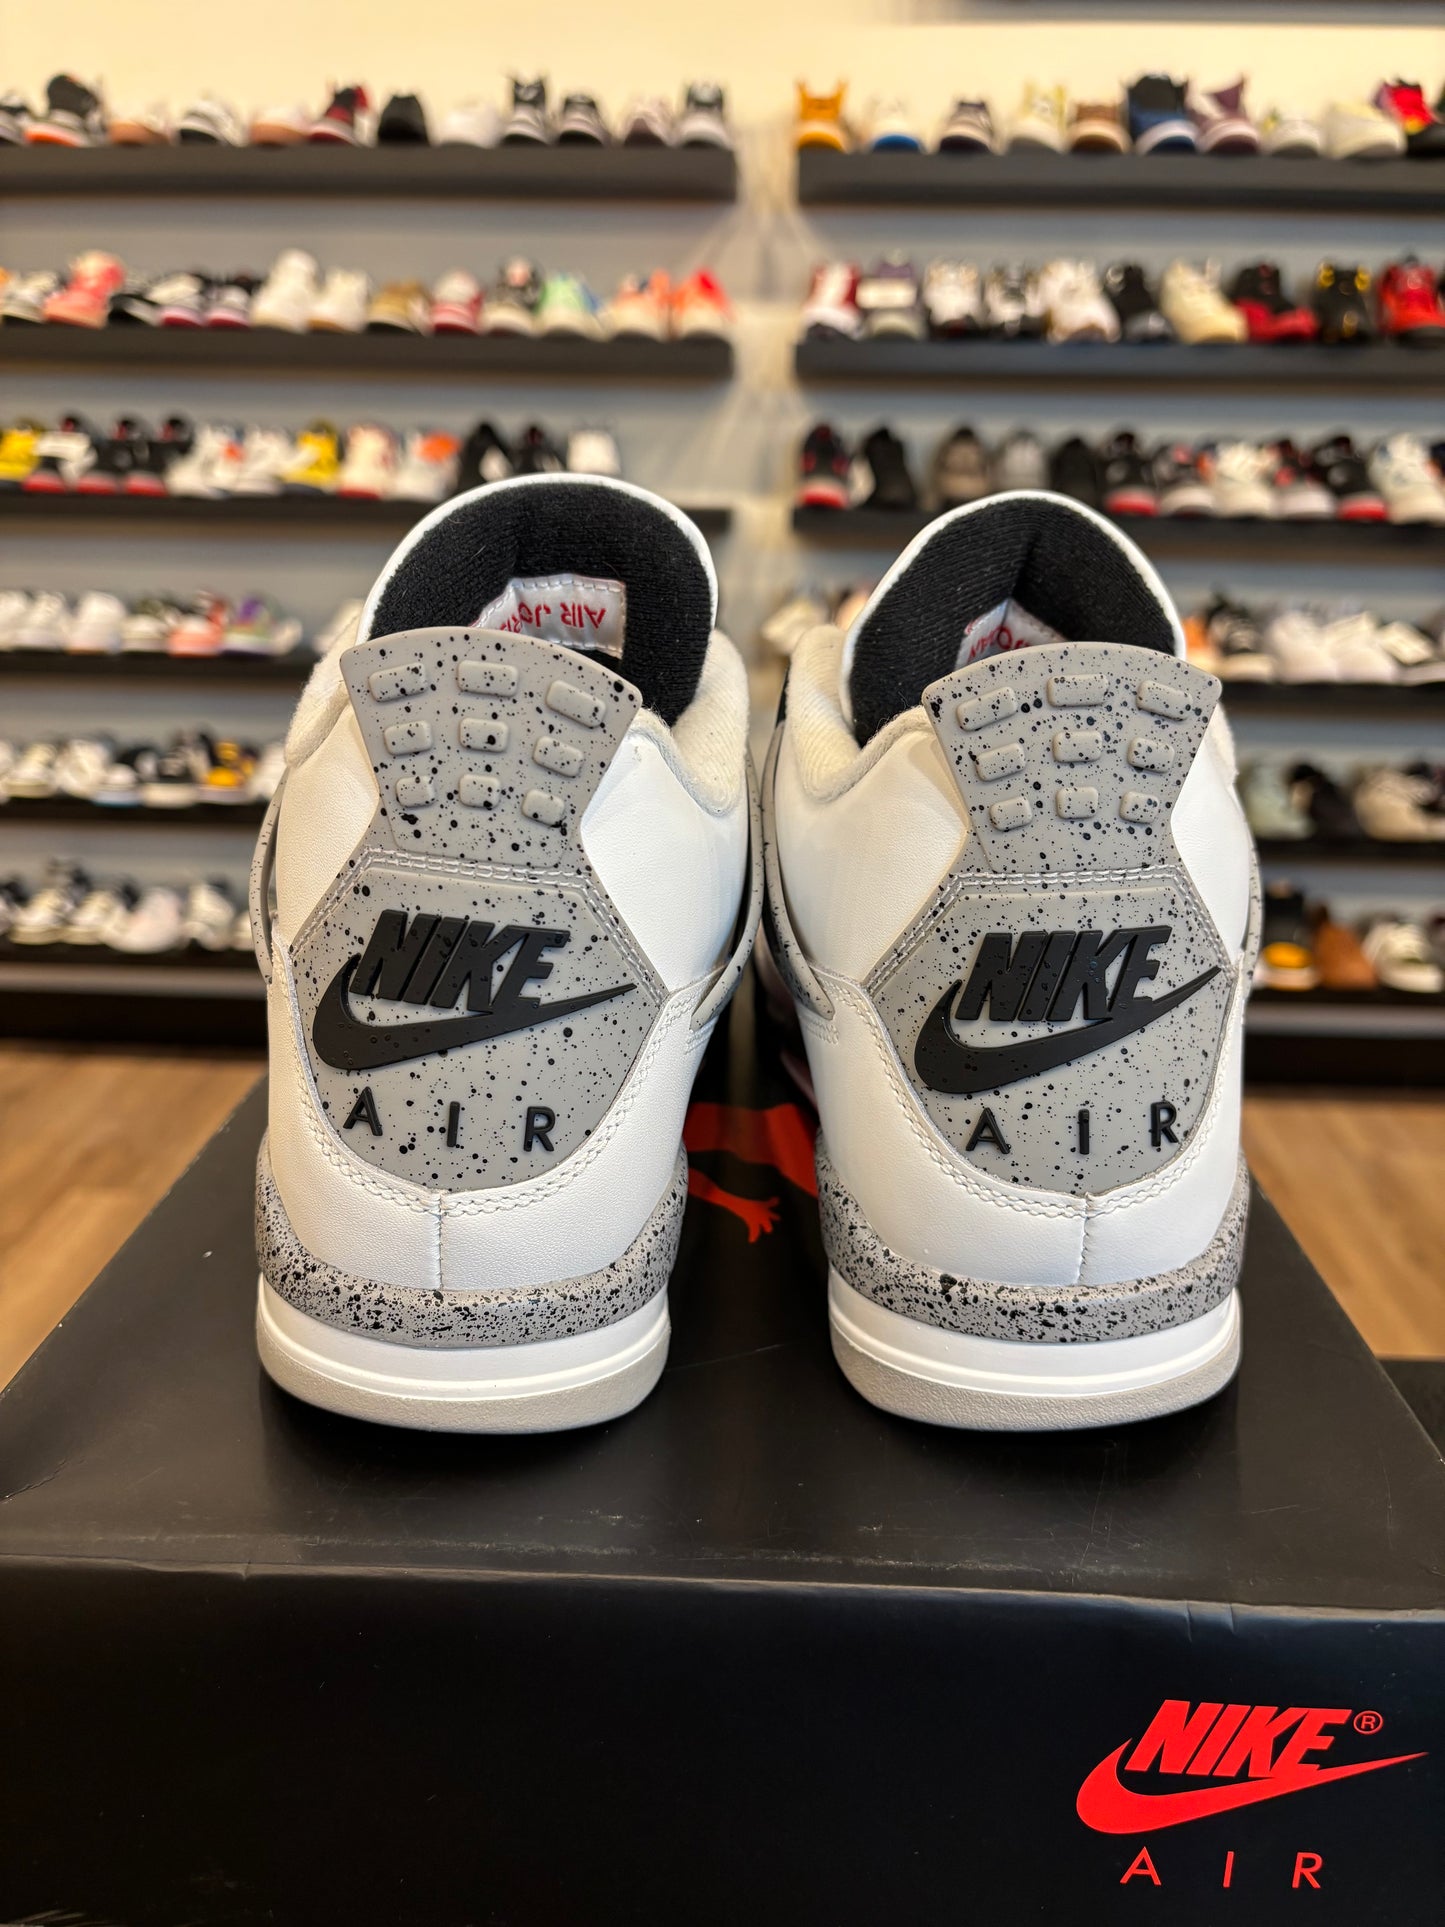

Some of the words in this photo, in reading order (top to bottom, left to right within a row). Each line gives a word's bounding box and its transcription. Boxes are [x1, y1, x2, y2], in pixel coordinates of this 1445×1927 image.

[560, 602, 606, 629] AIR
[349, 908, 571, 1014] NIKE
[954, 924, 1173, 1022] NIKE
